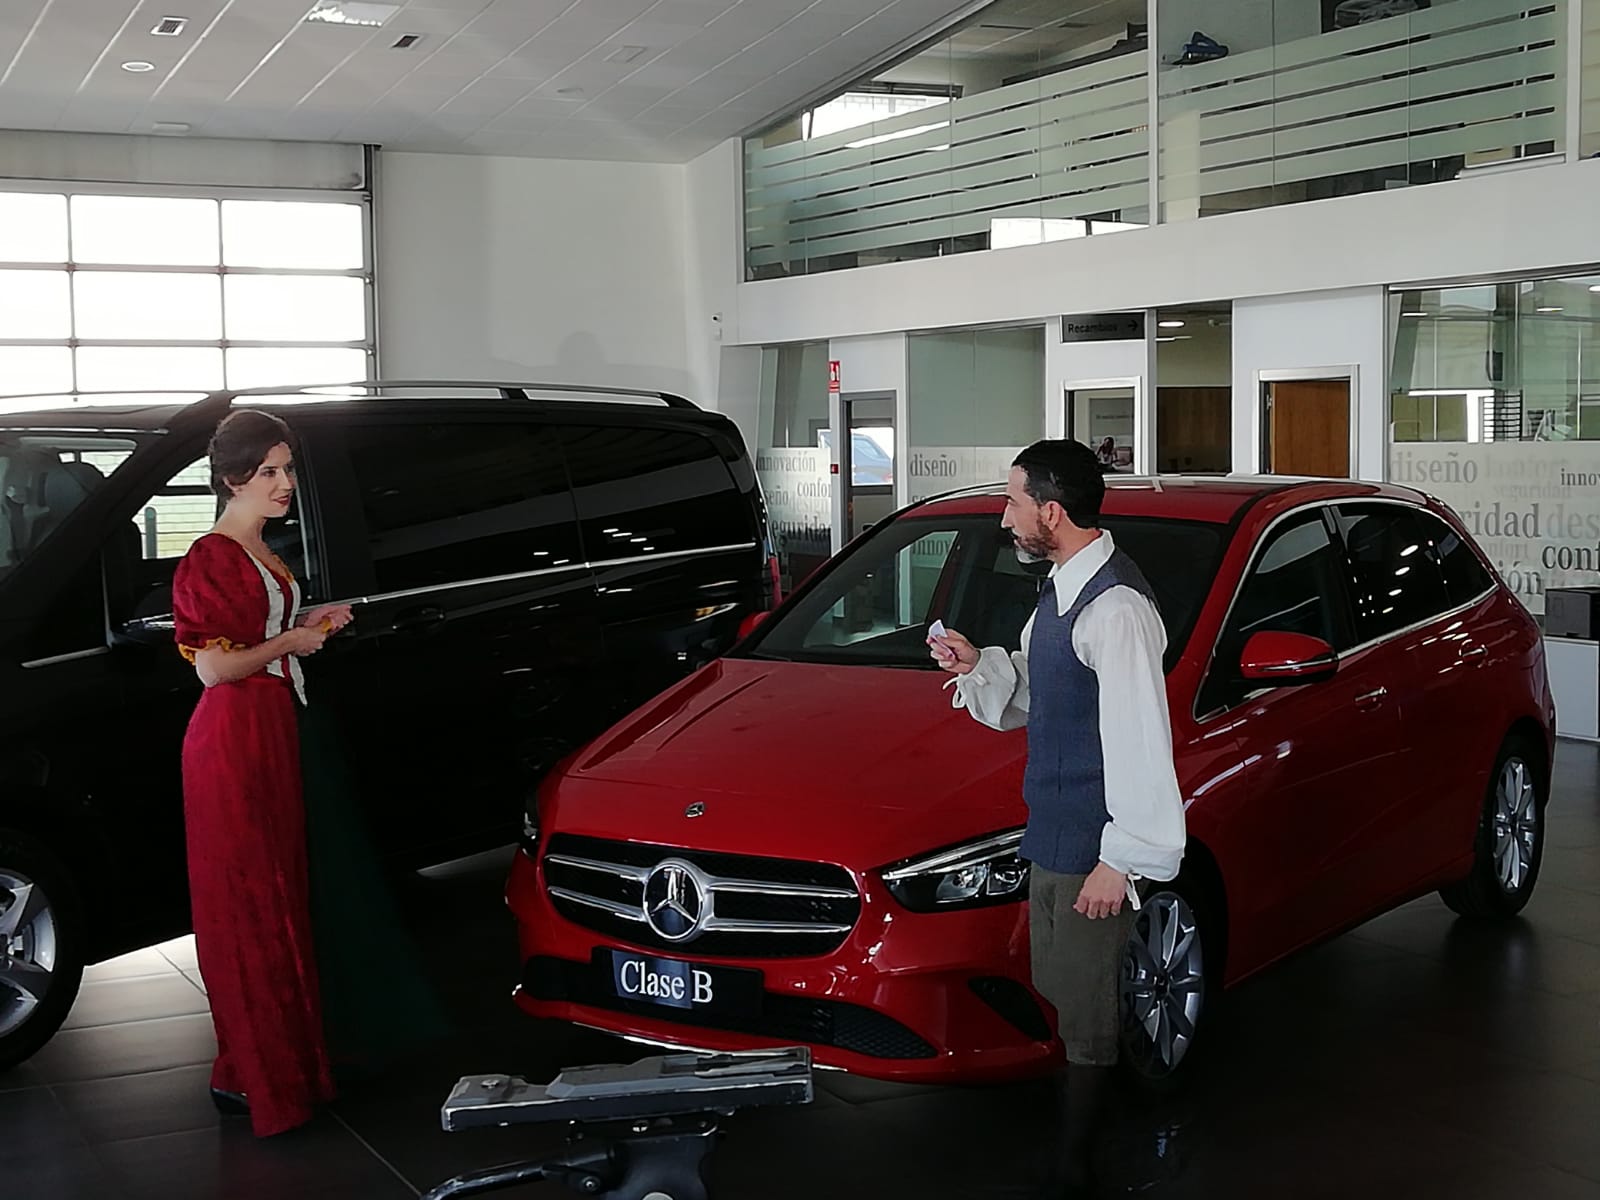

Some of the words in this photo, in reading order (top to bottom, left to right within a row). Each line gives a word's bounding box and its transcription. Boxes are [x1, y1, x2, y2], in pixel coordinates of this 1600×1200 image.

[910, 454, 957, 477] diseño
[1391, 451, 1478, 484] diseño
[620, 960, 685, 1000] Clase
[691, 969, 713, 1003] B
